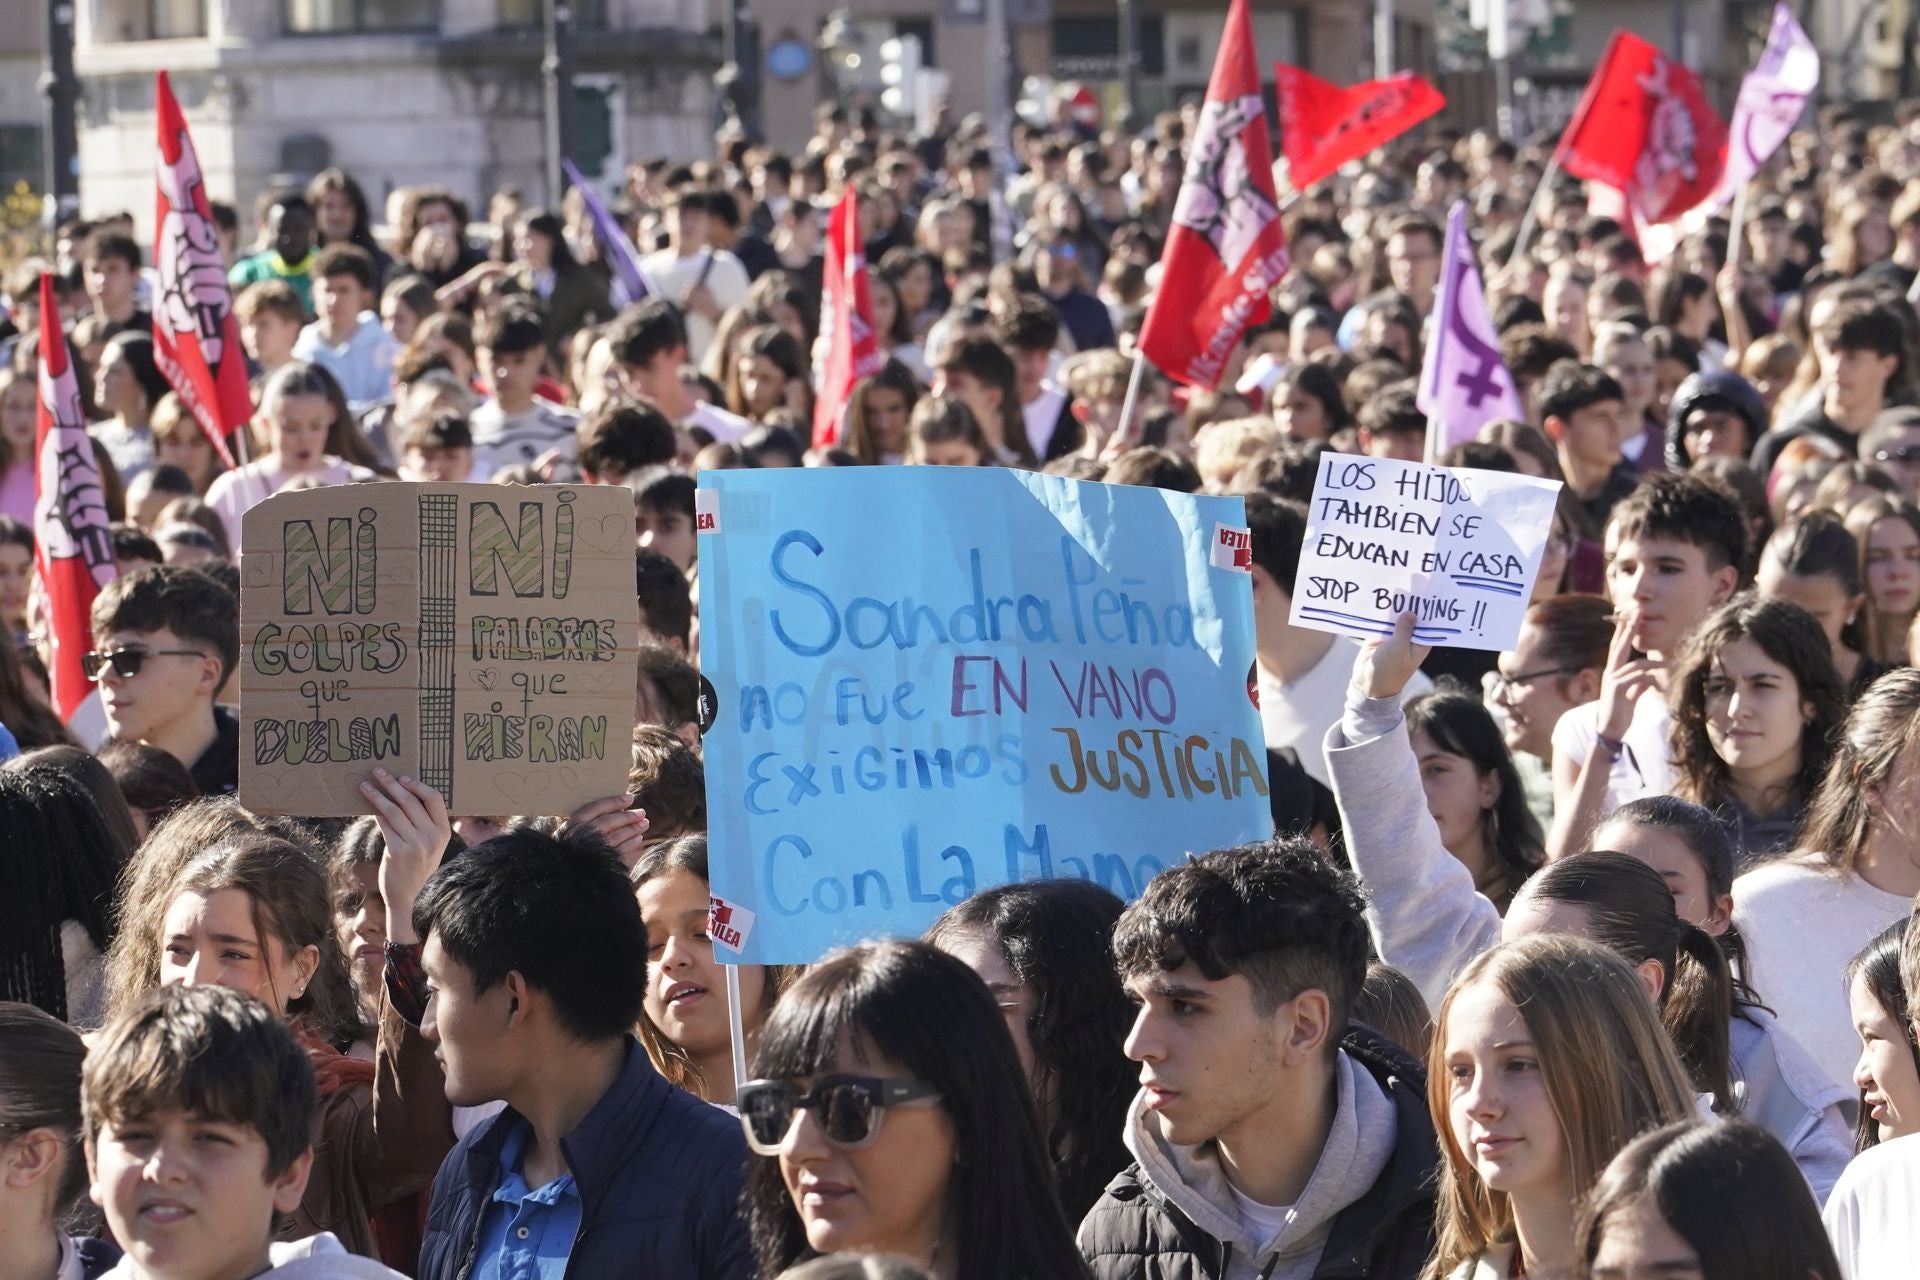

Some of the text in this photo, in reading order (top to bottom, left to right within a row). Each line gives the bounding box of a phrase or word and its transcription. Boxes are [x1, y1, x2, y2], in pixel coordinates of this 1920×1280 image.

[1324, 460, 1377, 491] LOS
[1449, 513, 1483, 539] SE
[1315, 532, 1524, 576] EDUCAN EN CASA
[769, 529, 1060, 658] Sandra
[1305, 576, 1360, 603] STOP
[252, 622, 408, 676] GOLPES
[471, 615, 618, 662] PALABRAS
[300, 679, 352, 722] que
[511, 672, 568, 718] que
[739, 681, 808, 733] no
[950, 655, 1028, 718] EN
[1049, 658, 1177, 725] VANO
[254, 713, 401, 766] DUELAN
[763, 833, 894, 917] Con
[902, 820, 977, 907] La
